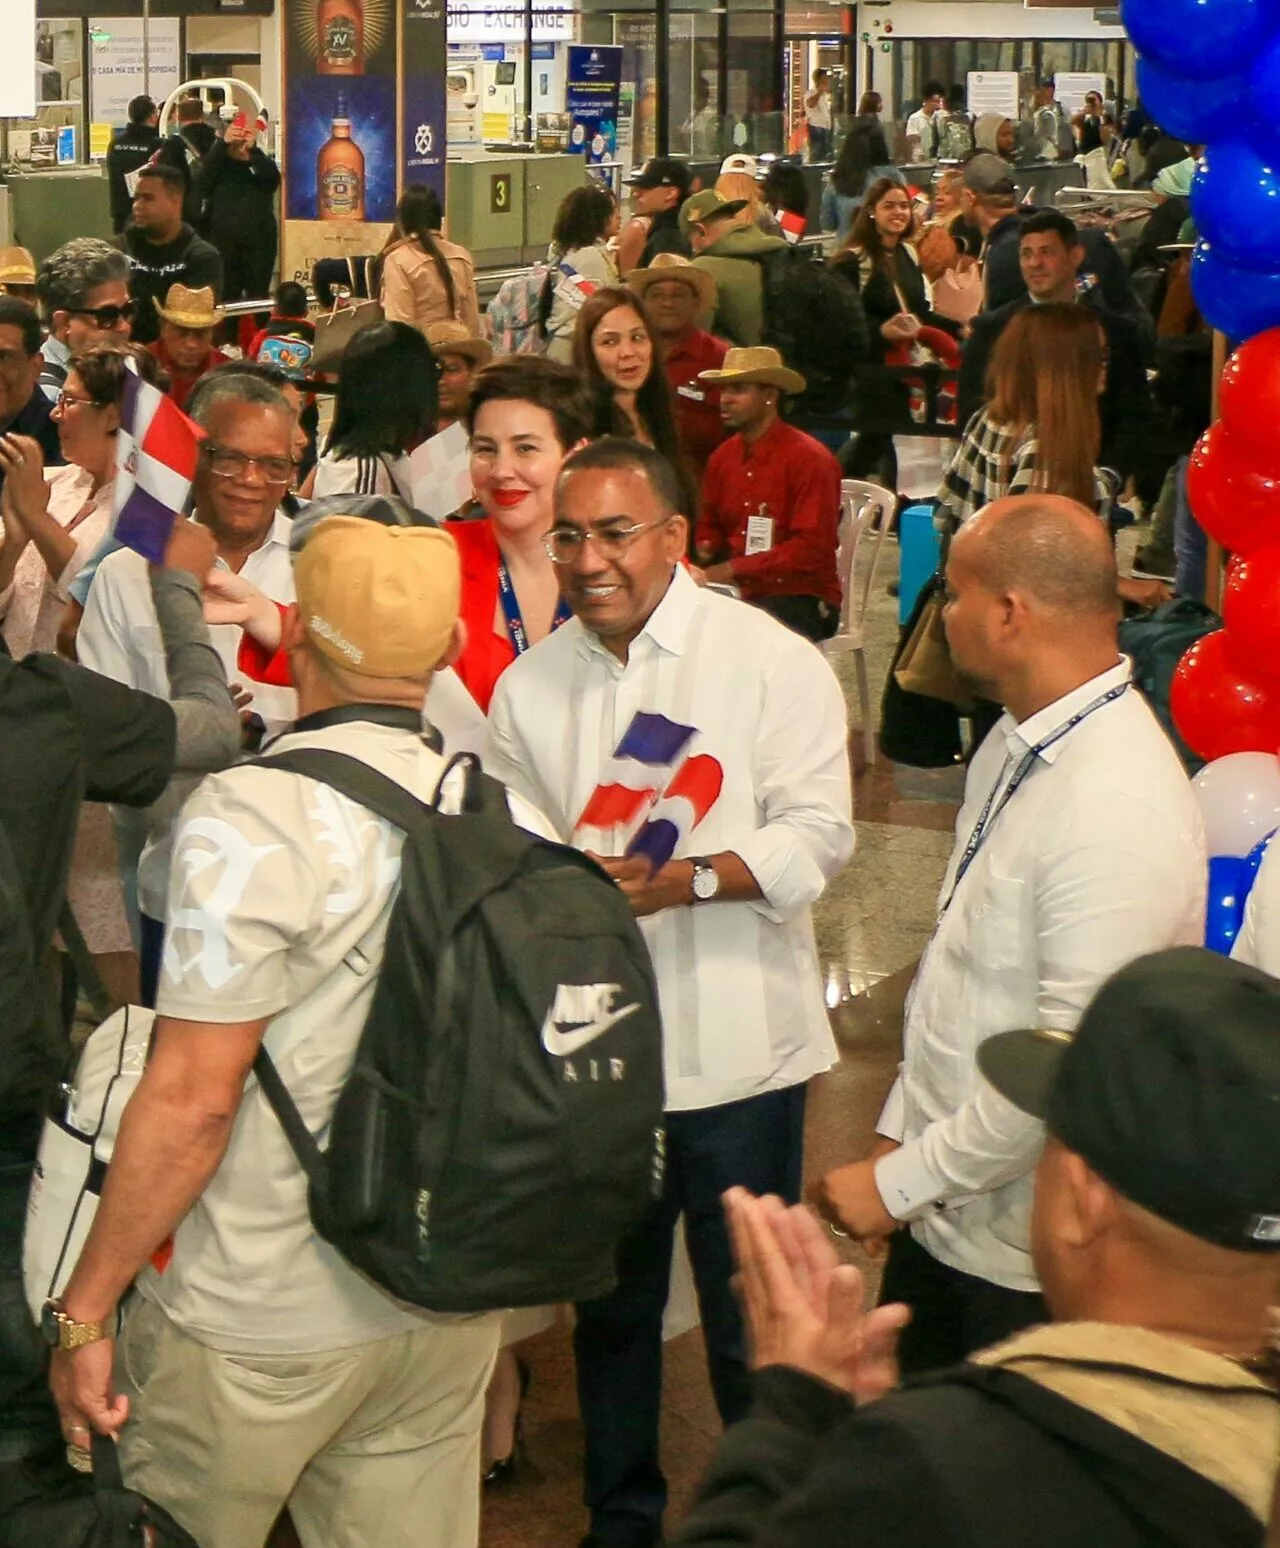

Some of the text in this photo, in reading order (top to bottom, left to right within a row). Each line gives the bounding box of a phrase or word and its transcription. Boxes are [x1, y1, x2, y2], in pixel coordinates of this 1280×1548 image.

[484, 5, 564, 28] EXCHNGE
[495, 184, 507, 207] 3
[553, 983, 624, 1023] NIKE
[563, 1057, 626, 1082] AIR
